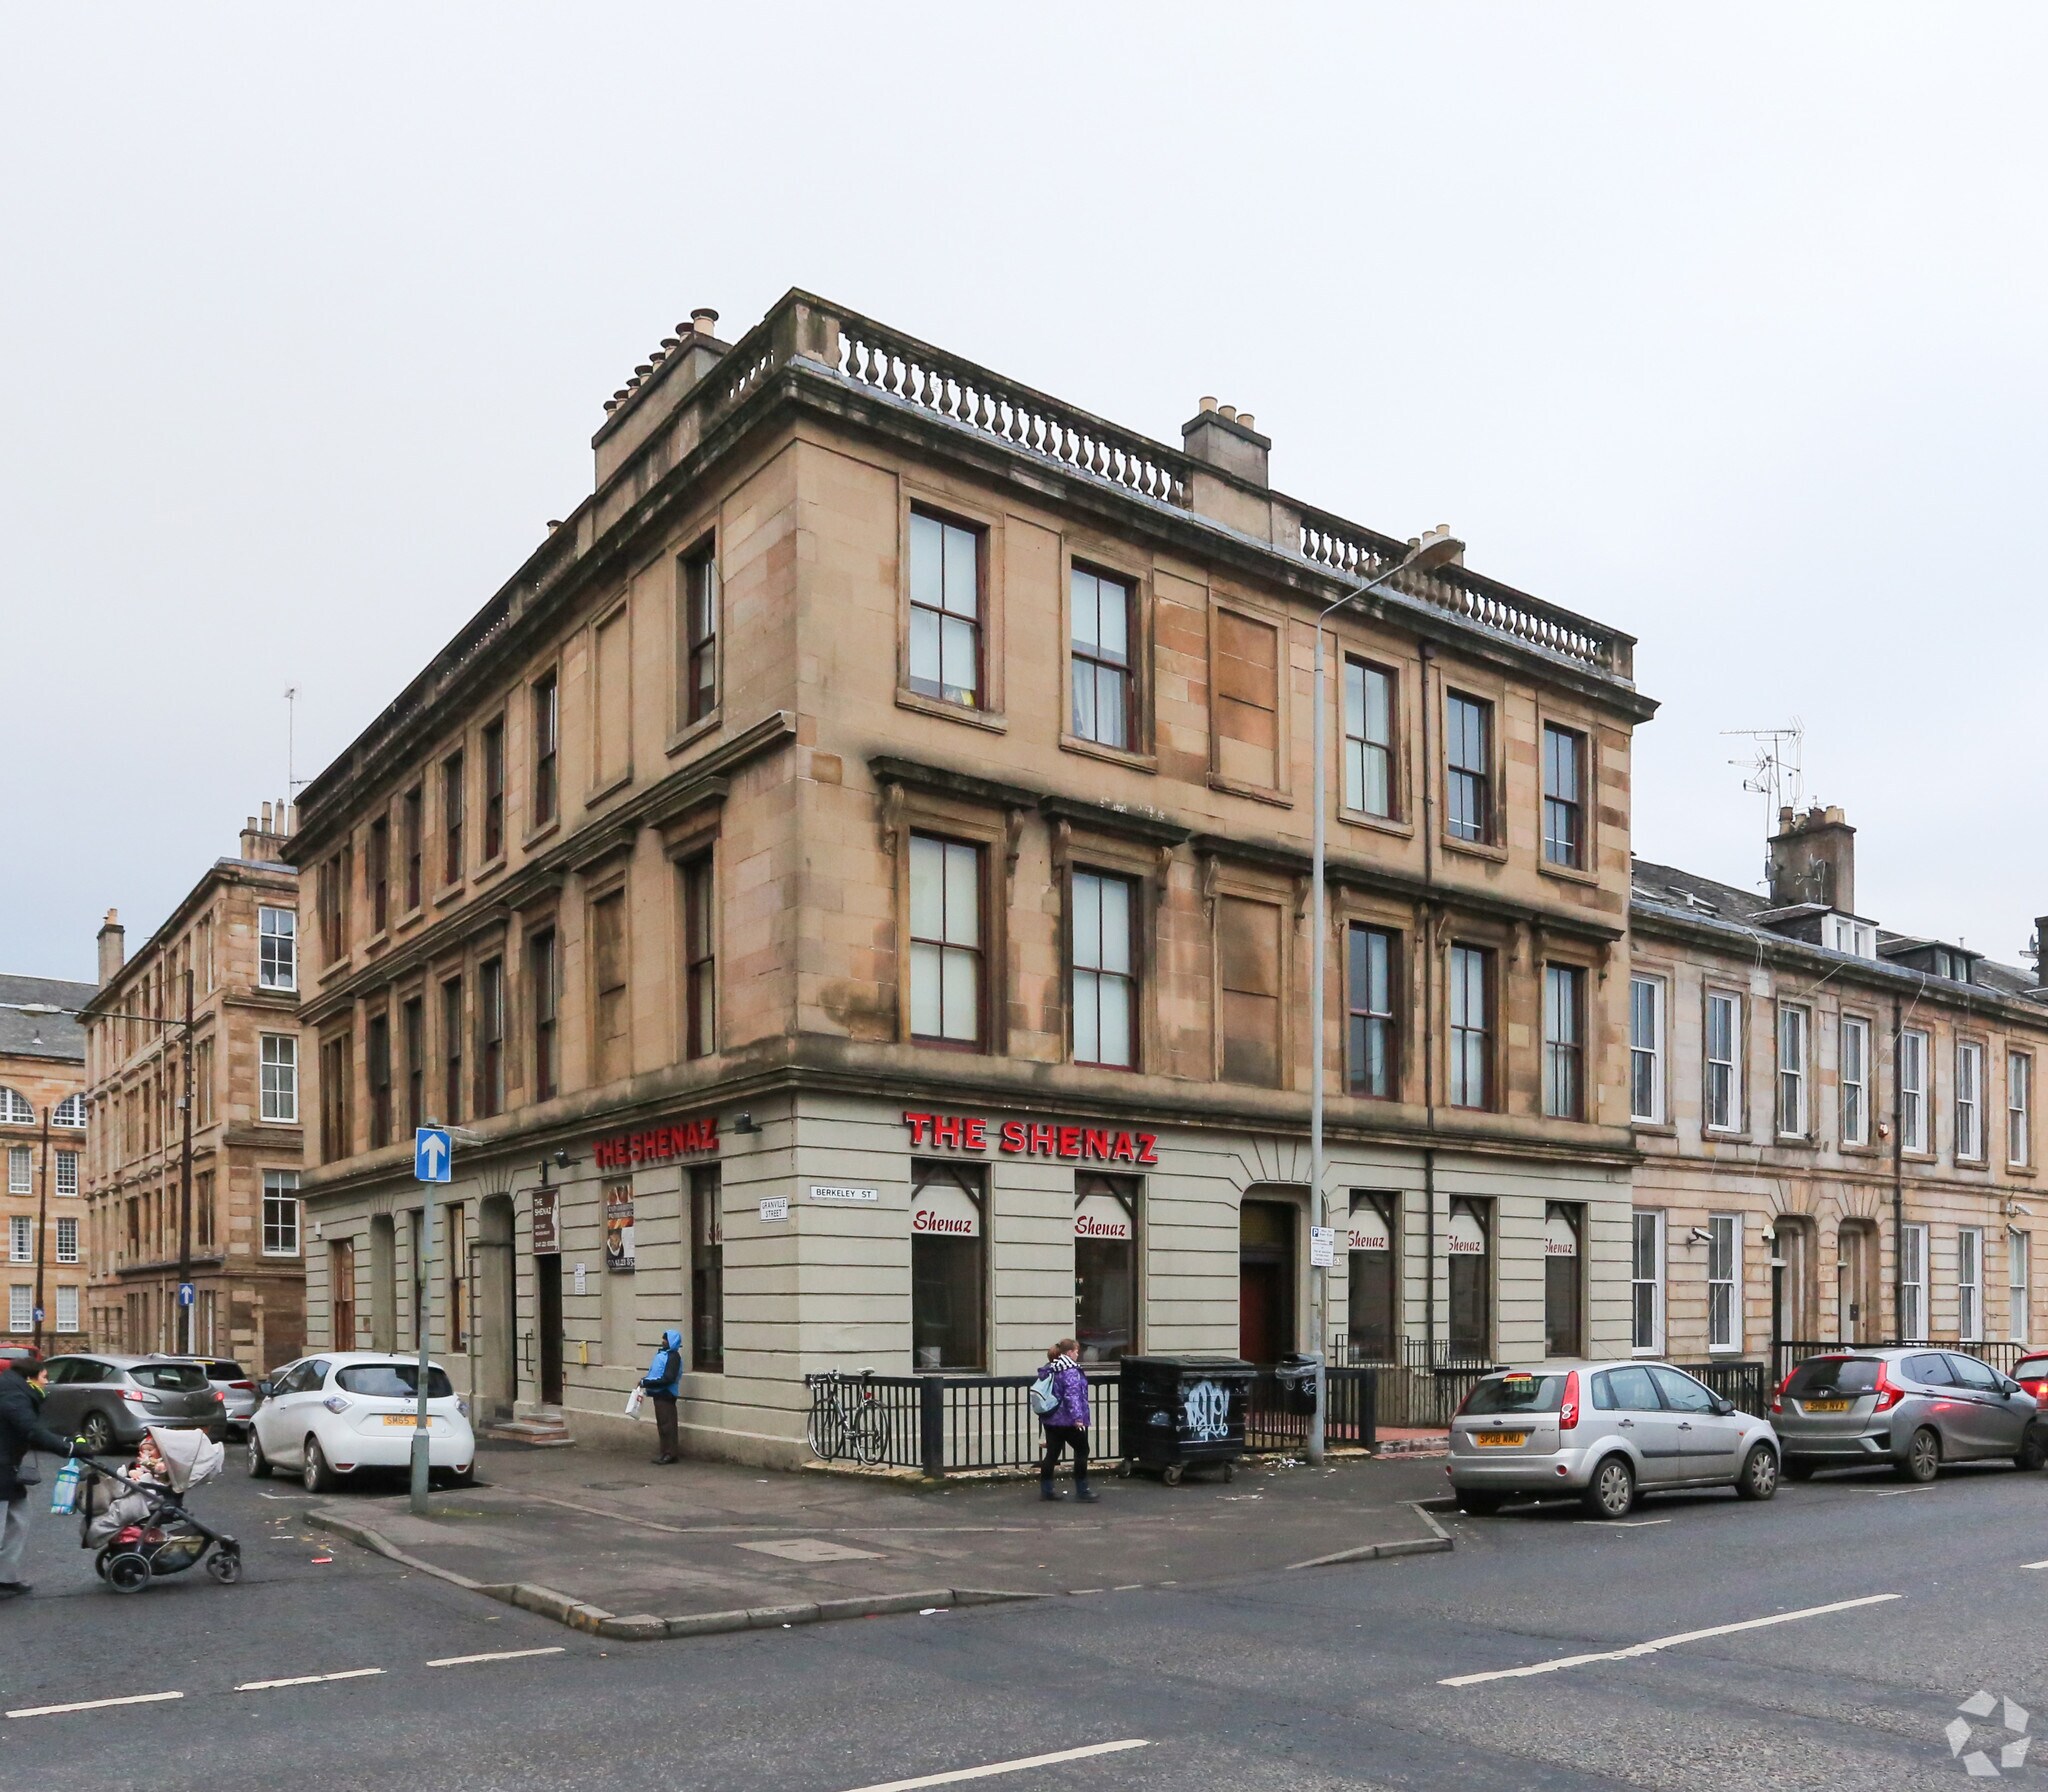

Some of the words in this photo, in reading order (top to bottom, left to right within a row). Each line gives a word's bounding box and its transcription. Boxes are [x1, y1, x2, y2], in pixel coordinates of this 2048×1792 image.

[592, 1136, 631, 1168] THE
[630, 1119, 719, 1164] SHENAZ
[902, 1111, 987, 1150] THE
[1000, 1121, 1159, 1164] SHENAZ
[816, 1188, 856, 1198] BERKELEY
[861, 1190, 872, 1198] ST
[761, 1199, 786, 1210] GRANVILLE
[765, 1209, 782, 1218] STREET
[912, 1210, 972, 1233] Shenaz
[1074, 1215, 1126, 1237] Shenaz
[1348, 1230, 1385, 1248] Shenaz
[1479, 1433, 1501, 1444] SP08
